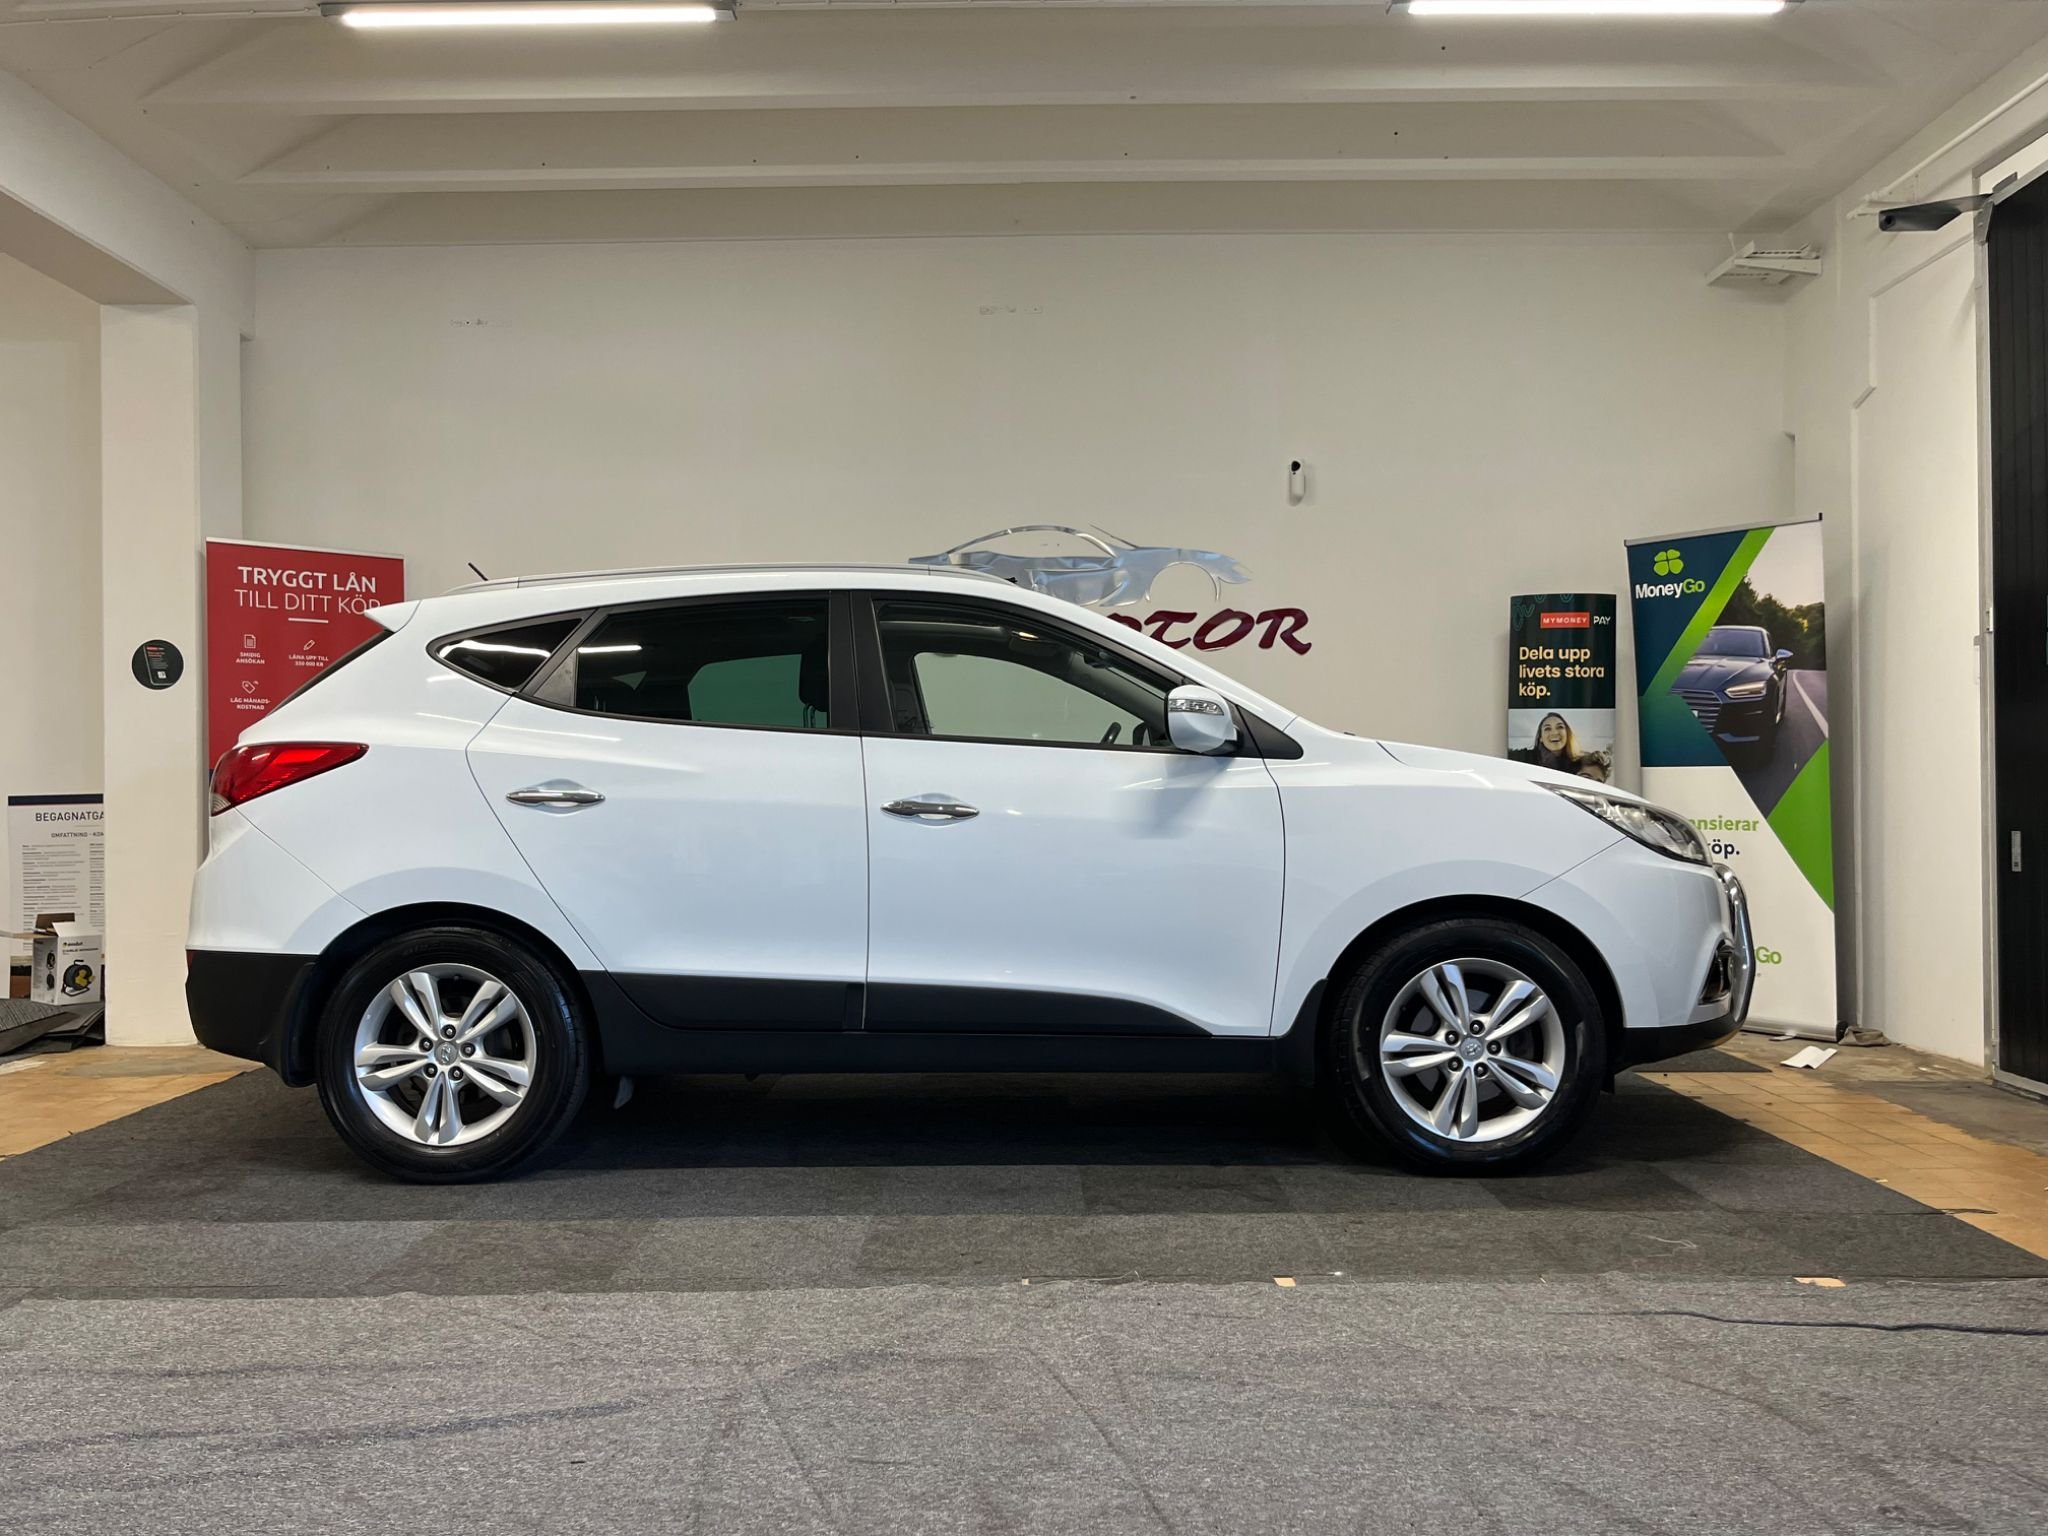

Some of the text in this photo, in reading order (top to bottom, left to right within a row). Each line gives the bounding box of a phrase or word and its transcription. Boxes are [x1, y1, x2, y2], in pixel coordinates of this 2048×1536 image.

[237, 566, 377, 593] TRYGGT LÅN
[1635, 578, 1706, 599] MoneyGo
[234, 589, 279, 609] TILL
[285, 592, 333, 613] DITT
[1543, 615, 1612, 625] MYMONEY PAY
[1519, 646, 1591, 663] Dela upp
[1519, 664, 1605, 678] livets stora
[1519, 682, 1551, 699] köp.
[230, 696, 243, 704] LÅG
[236, 703, 265, 711] KOSTNAD
